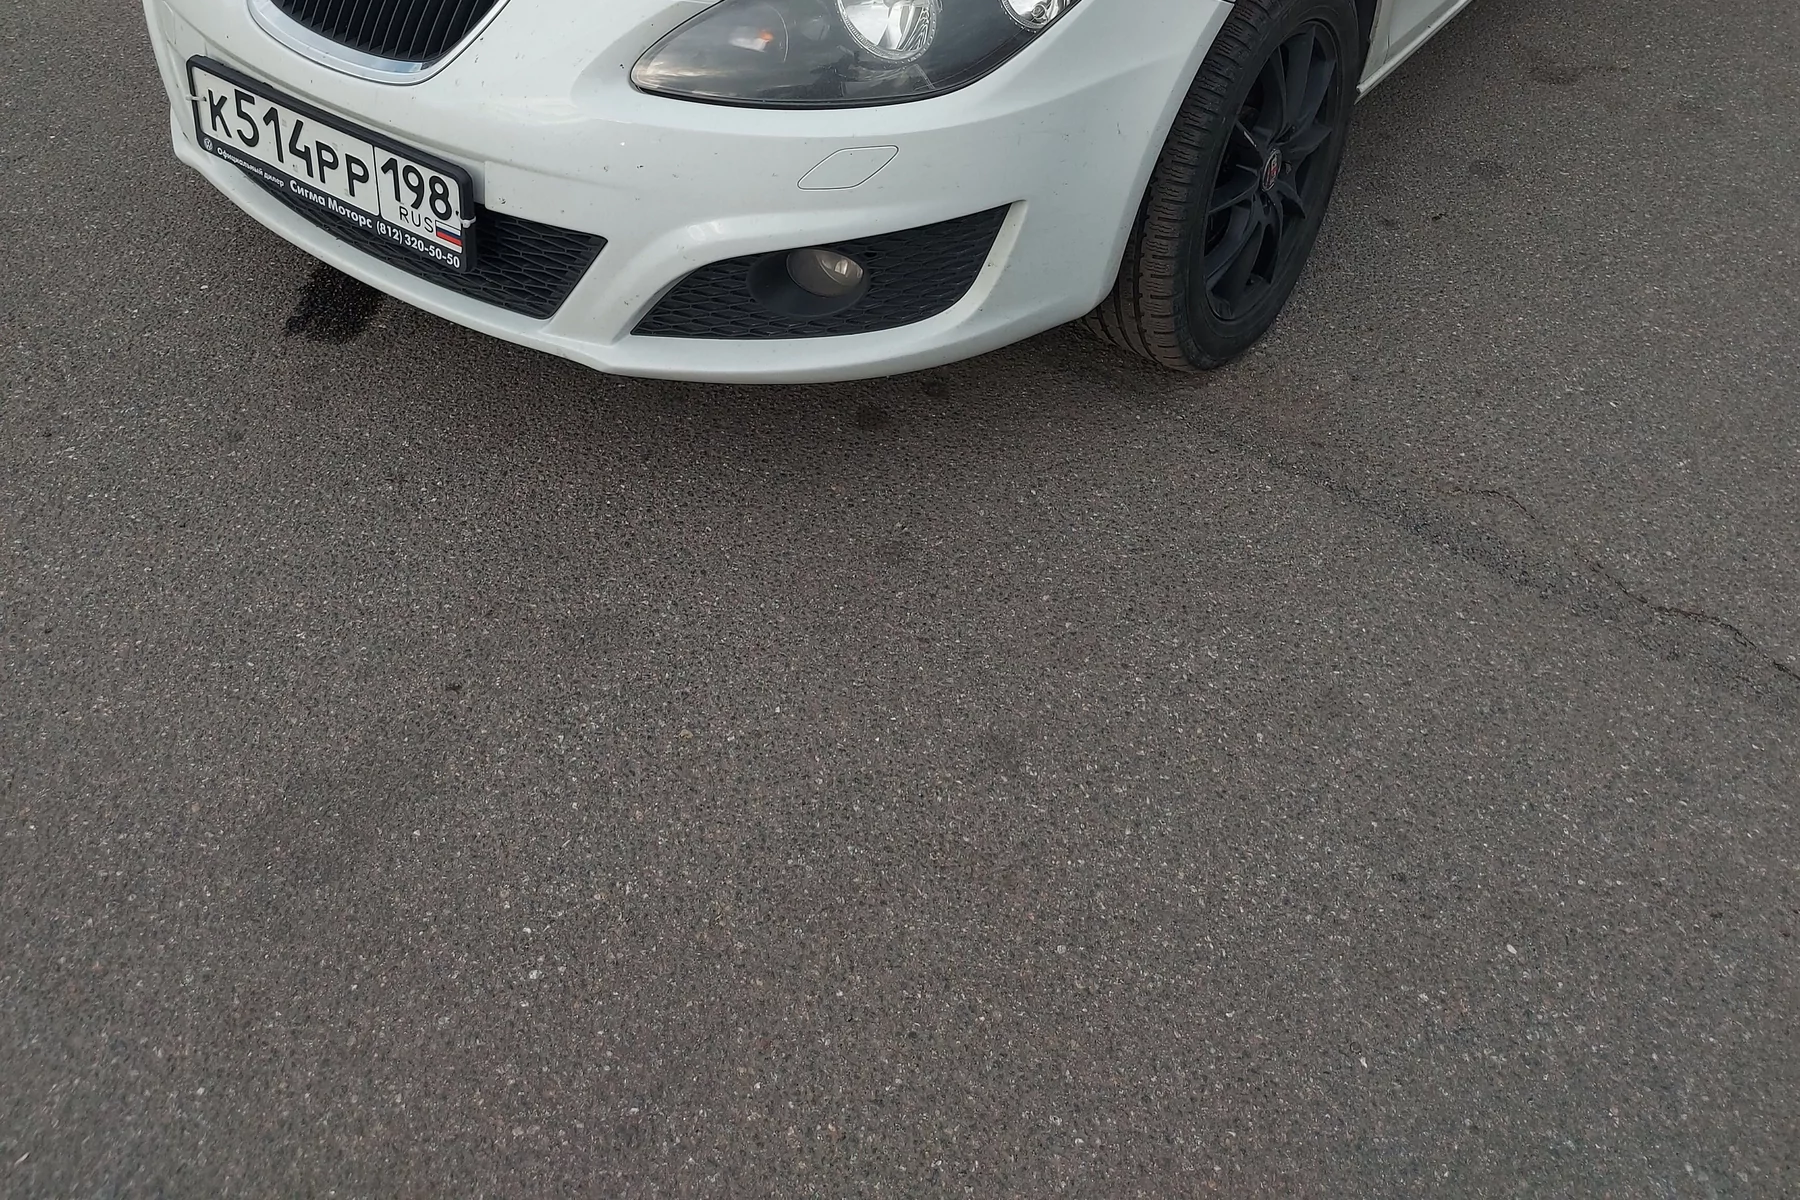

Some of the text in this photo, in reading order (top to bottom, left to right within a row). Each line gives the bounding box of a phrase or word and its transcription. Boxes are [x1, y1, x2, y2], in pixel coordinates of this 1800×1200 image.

[217, 147, 460, 268] Официальный дилер Сигма Моторс (812) 320-50-50
[381, 157, 452, 220] 198
[399, 205, 434, 233] RUS
